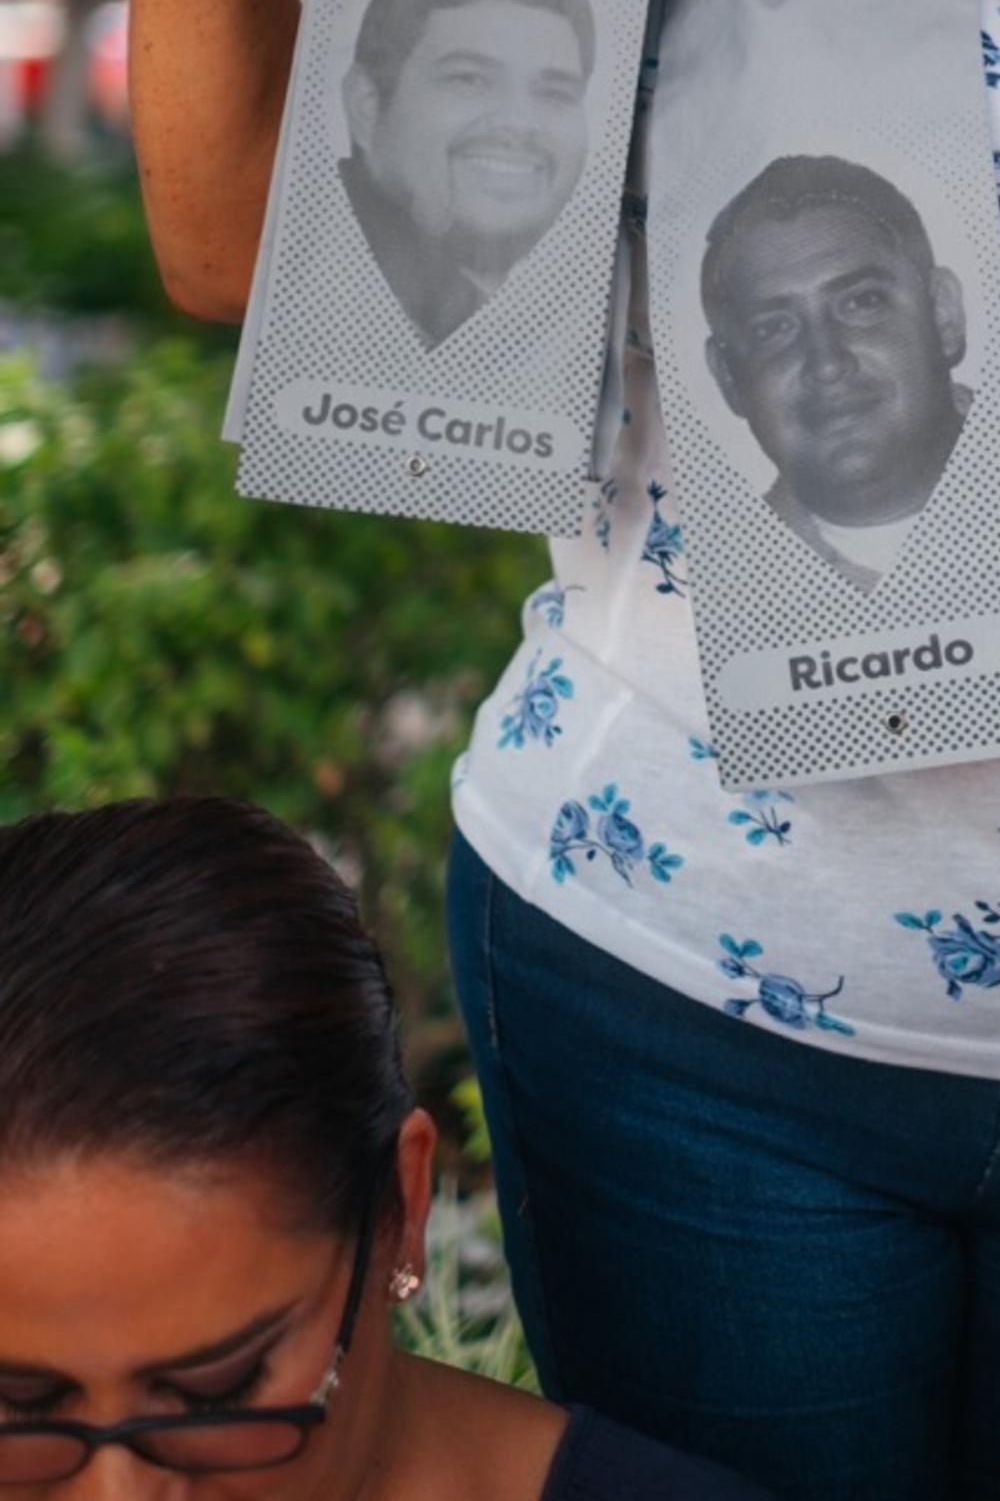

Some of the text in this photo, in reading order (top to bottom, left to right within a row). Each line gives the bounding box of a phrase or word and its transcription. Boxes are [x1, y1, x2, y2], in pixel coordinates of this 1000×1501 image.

[301, 393, 554, 458] José Carlos
[788, 634, 974, 691] Ricardo
